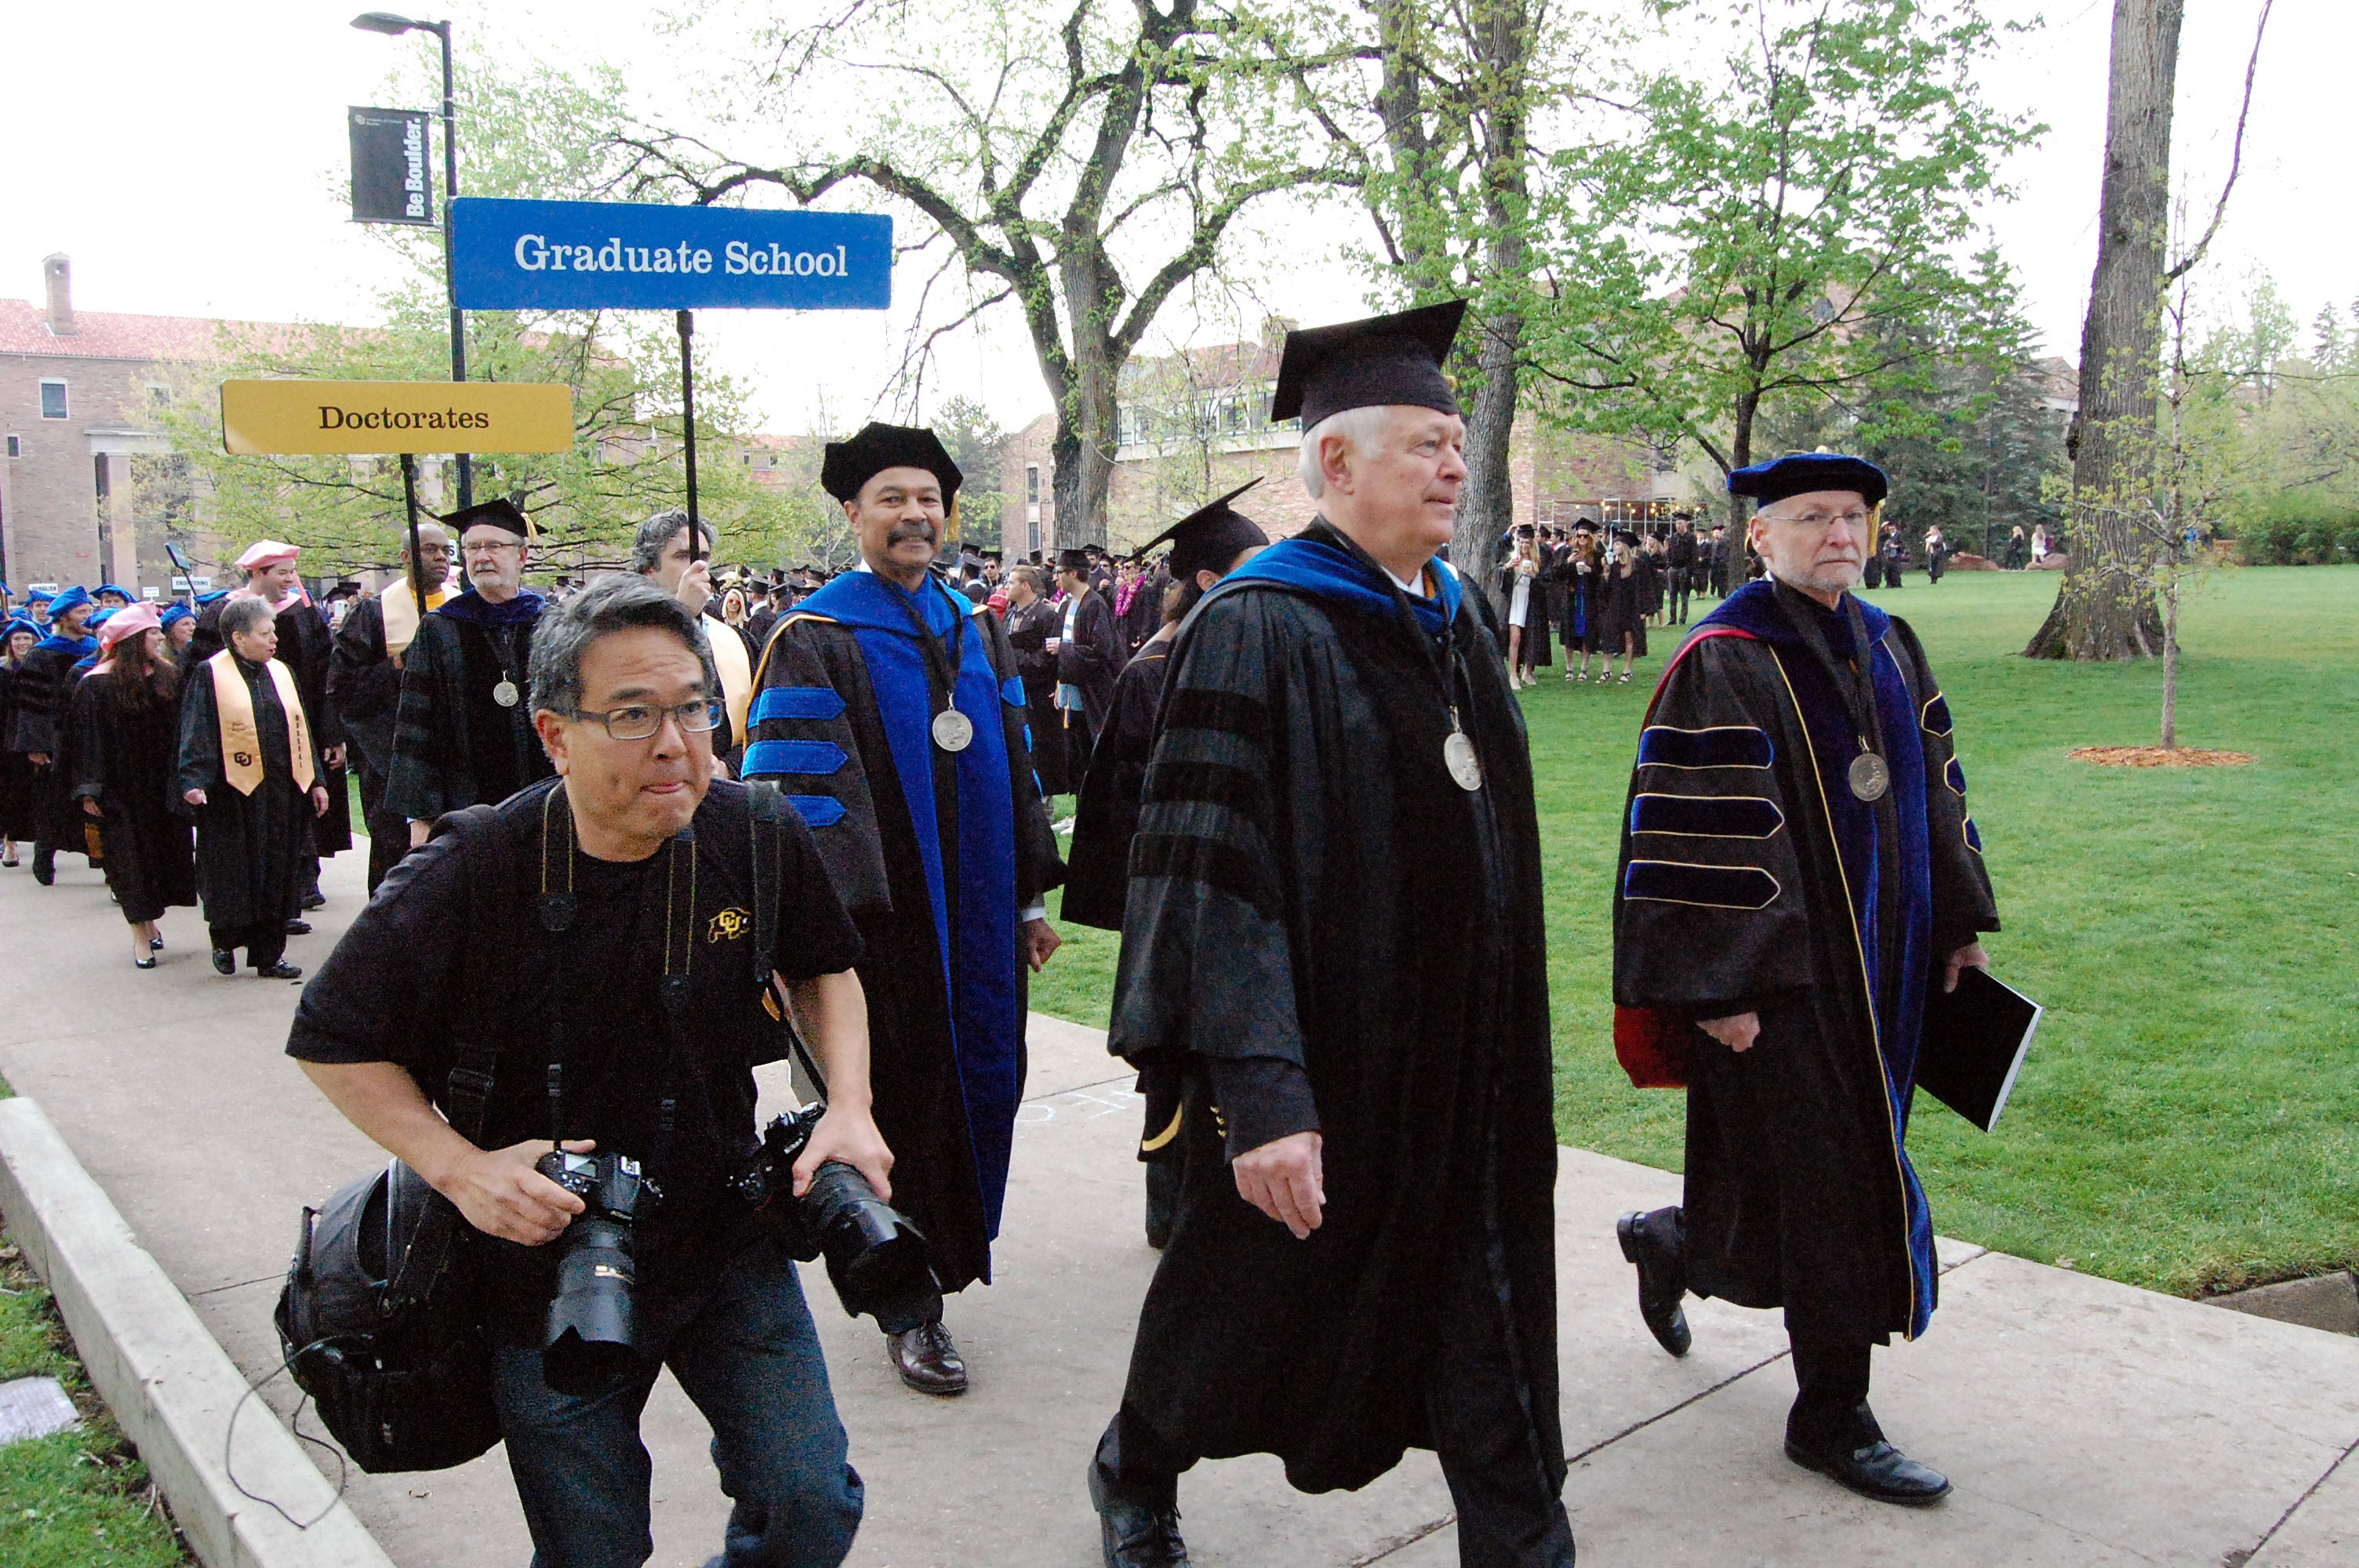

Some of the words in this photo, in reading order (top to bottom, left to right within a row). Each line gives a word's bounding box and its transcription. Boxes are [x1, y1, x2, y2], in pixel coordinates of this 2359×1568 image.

[403, 118, 423, 191] Boulder.
[405, 193, 425, 217] Be
[514, 234, 712, 274] Graduate
[725, 241, 849, 277] School
[318, 406, 489, 430] Doctorates
[234, 752, 253, 767] CU
[719, 911, 742, 933] CU
